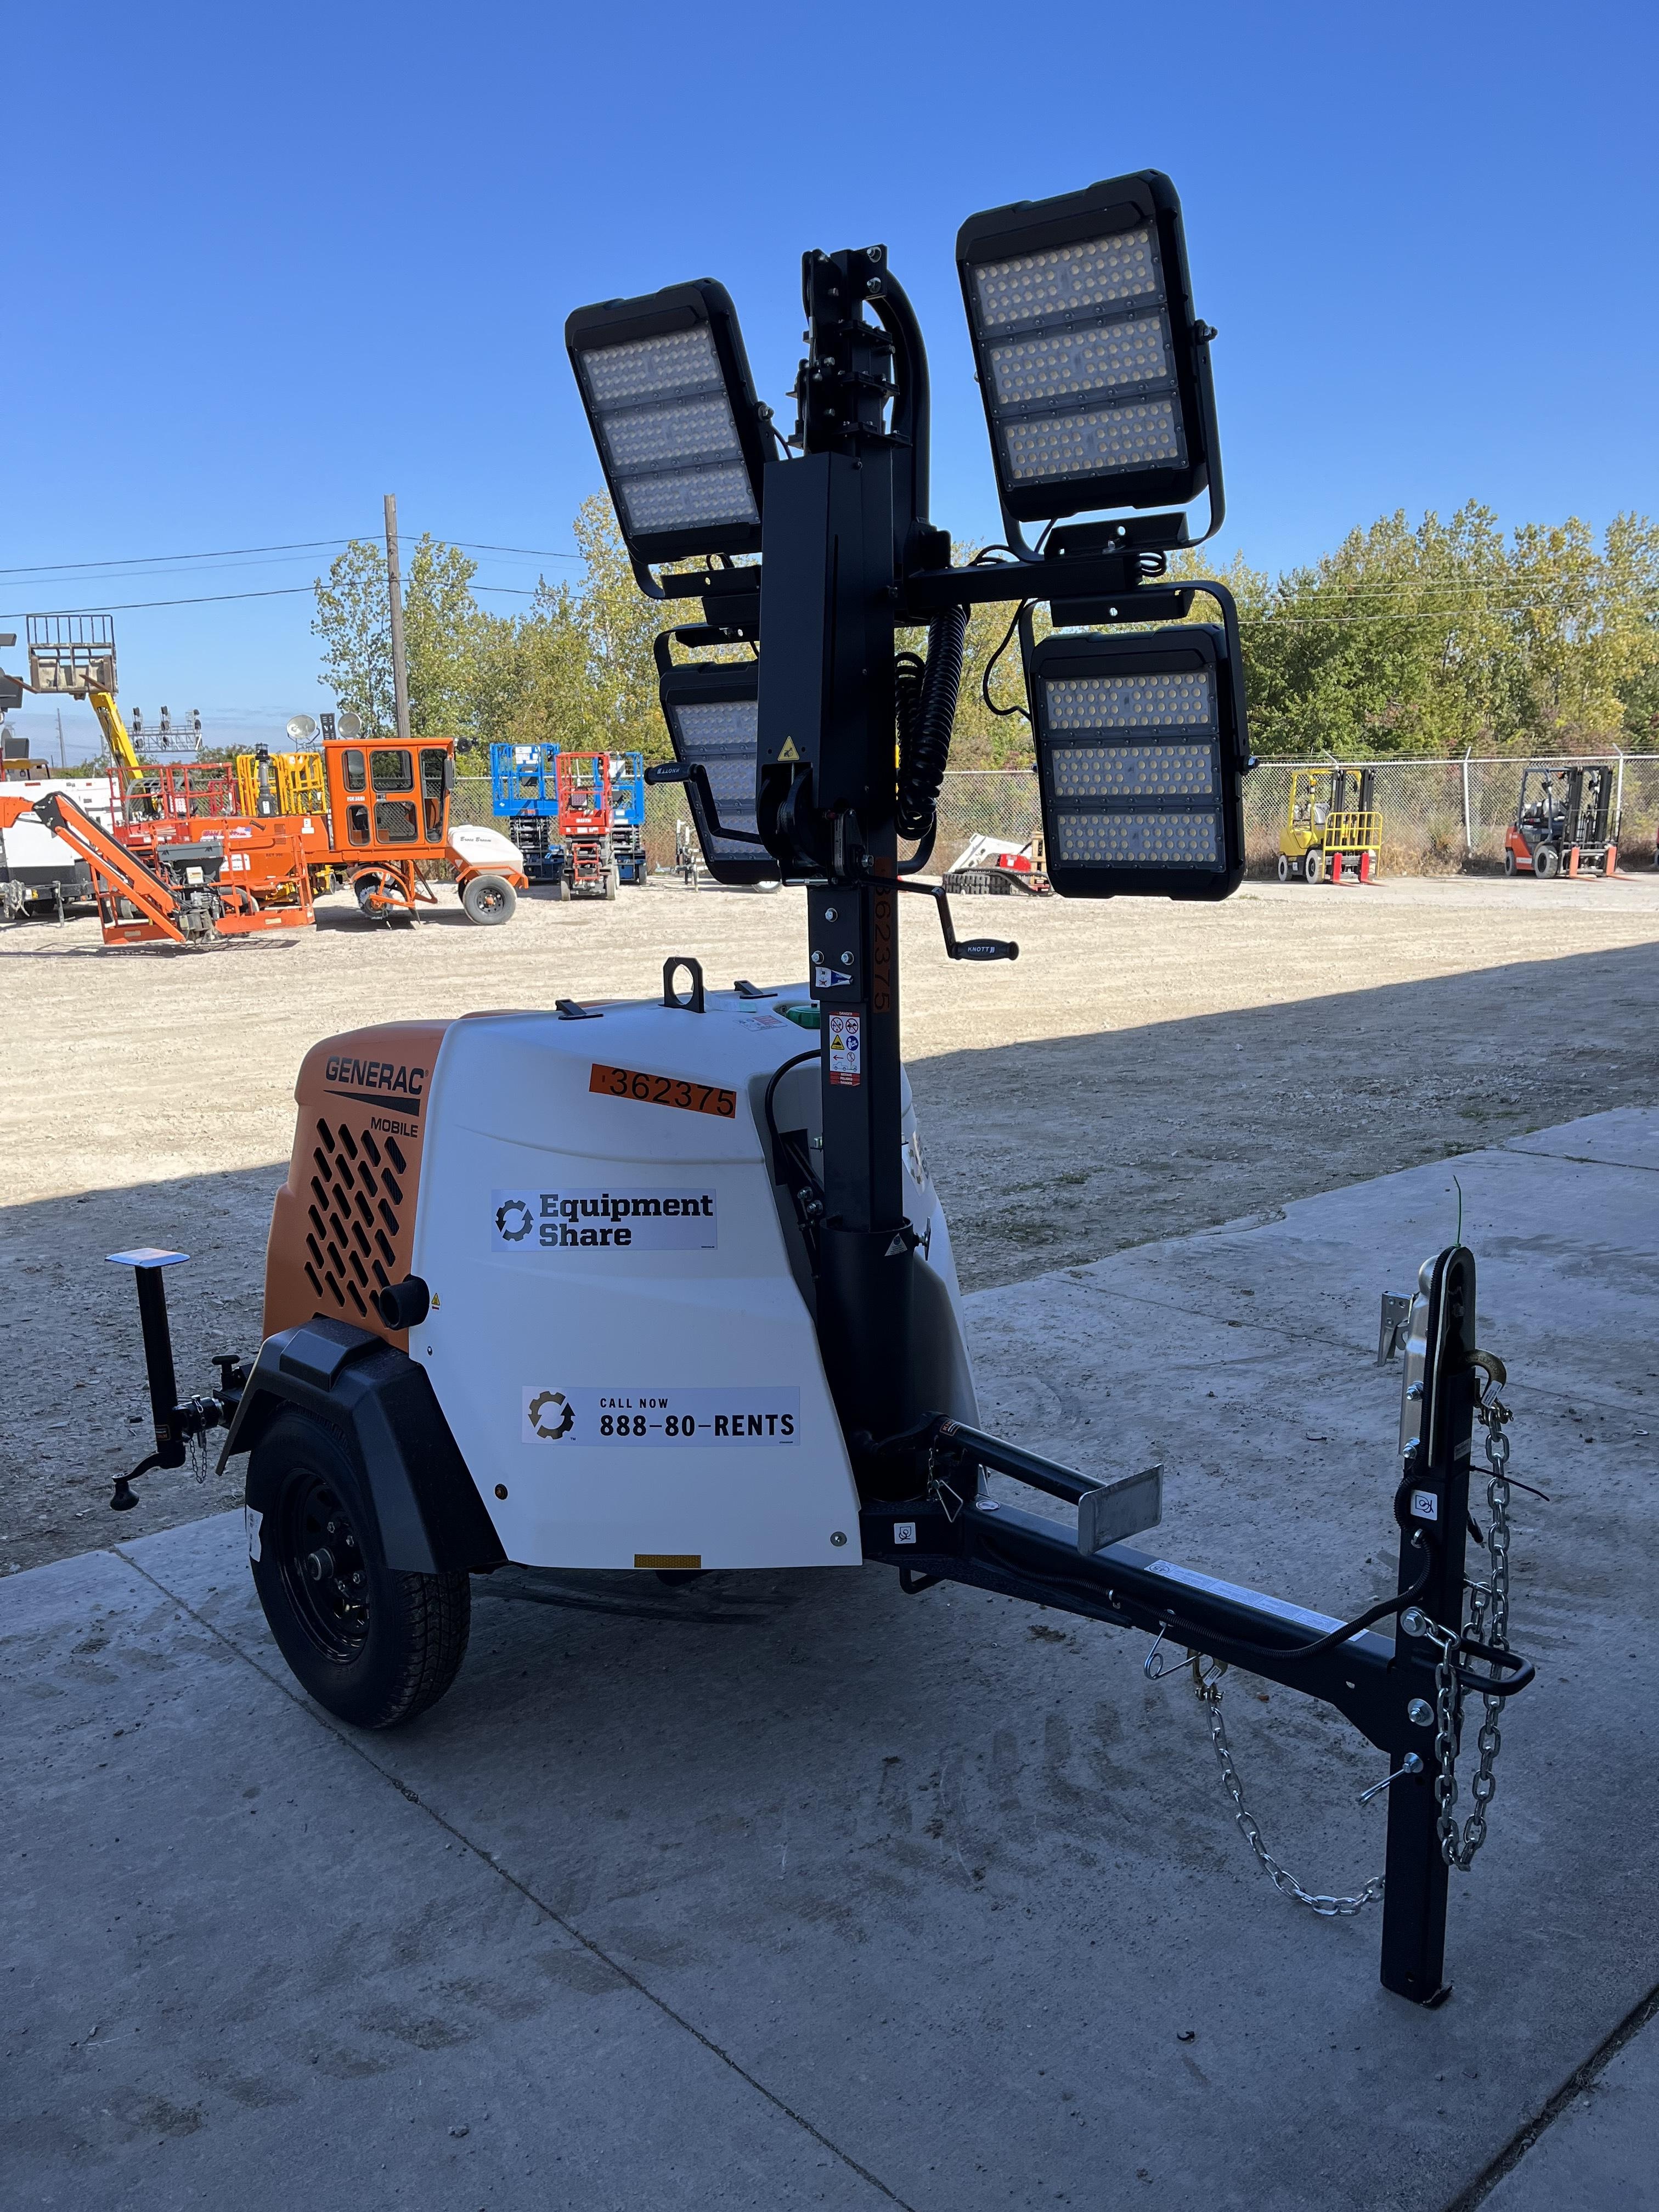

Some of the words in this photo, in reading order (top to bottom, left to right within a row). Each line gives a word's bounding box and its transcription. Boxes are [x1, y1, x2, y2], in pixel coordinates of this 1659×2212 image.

[326, 1056, 424, 1095] GENERAC
[610, 1068, 734, 1115] 362375
[370, 1116, 419, 1138] MOBILE
[539, 1193, 714, 1222] Equipment
[539, 1223, 632, 1246] Share
[600, 1398, 633, 1408] CALL
[640, 1398, 668, 1408] NOW
[600, 1414, 795, 1437] 888-80-RENTS
